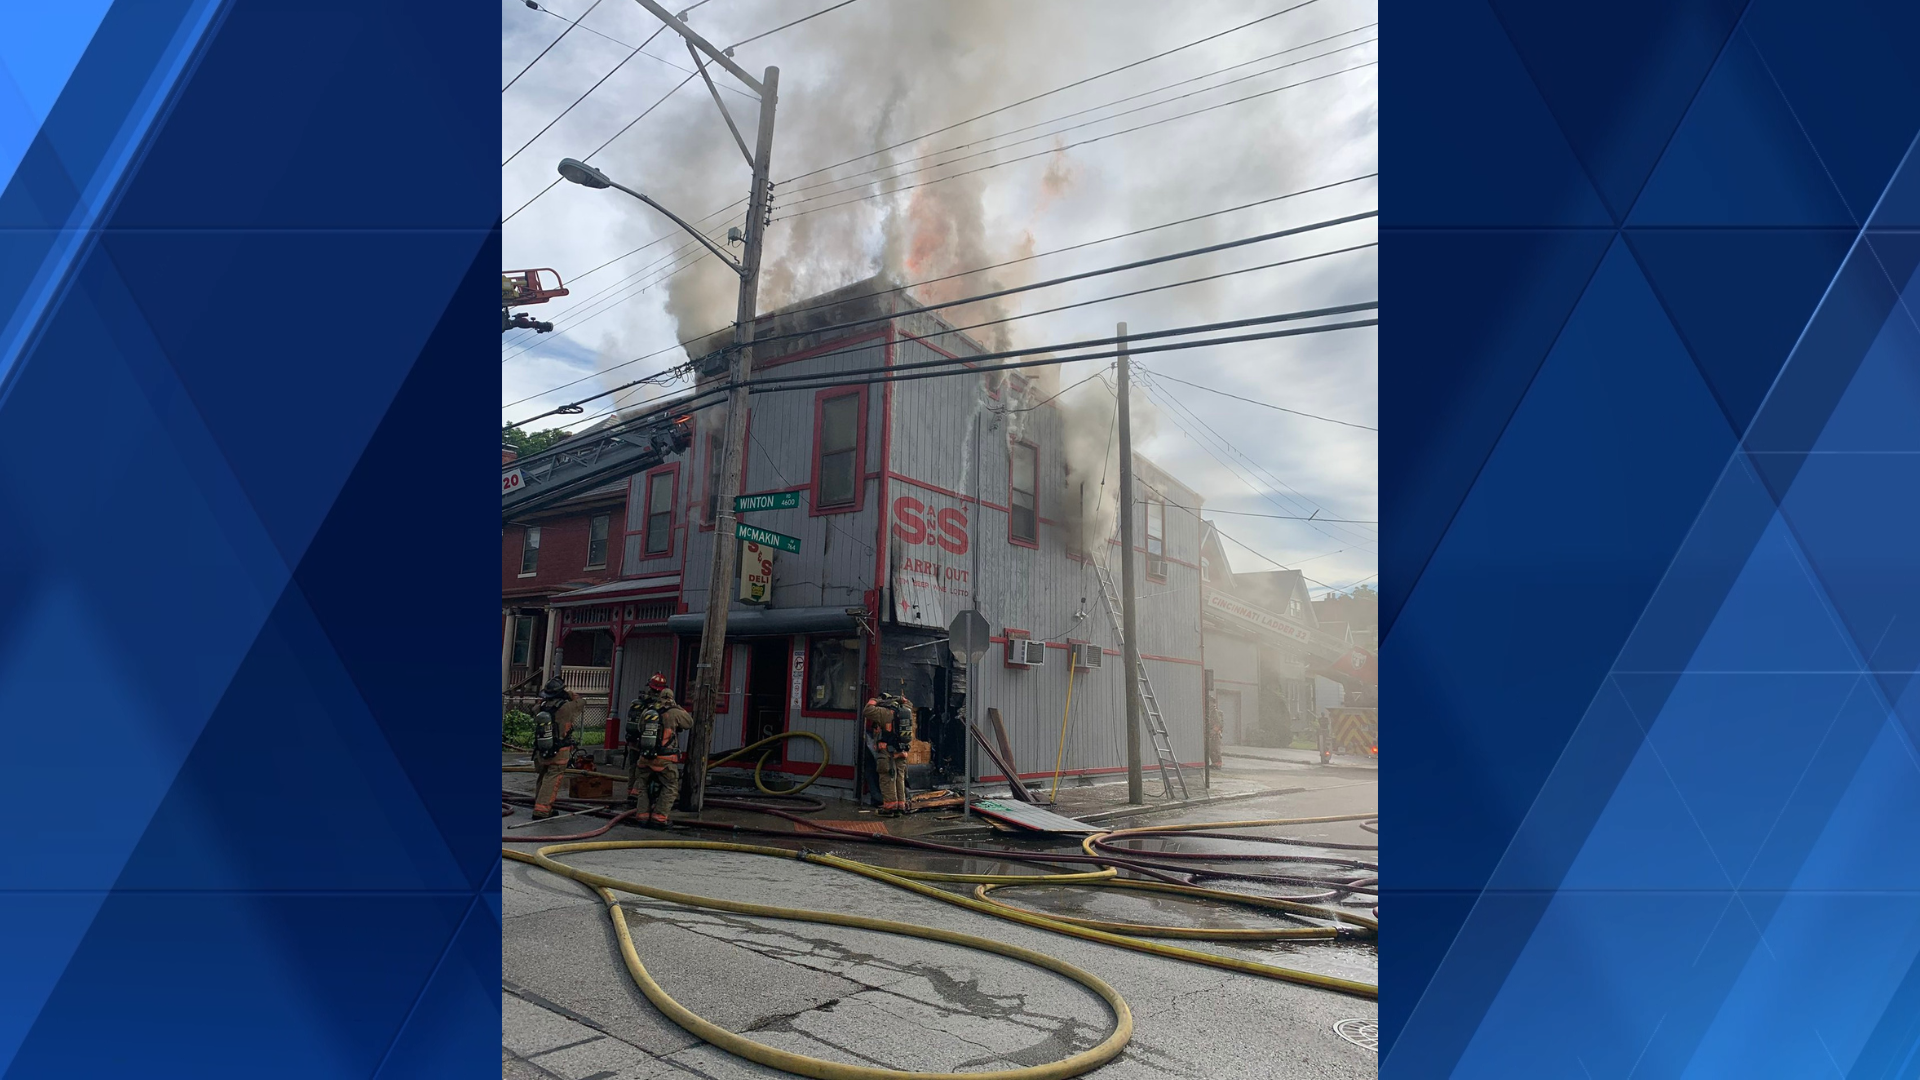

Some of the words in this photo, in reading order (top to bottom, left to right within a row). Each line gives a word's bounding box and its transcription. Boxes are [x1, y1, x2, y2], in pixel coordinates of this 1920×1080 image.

[503, 474, 519, 489] 20
[740, 496, 774, 509] WINTON
[748, 574, 769, 584] DELI
[945, 567, 969, 582] OUT
[950, 588, 968, 596] LOTTO
[1211, 596, 1260, 621] CINCINNATI
[1262, 616, 1294, 635] LADDER
